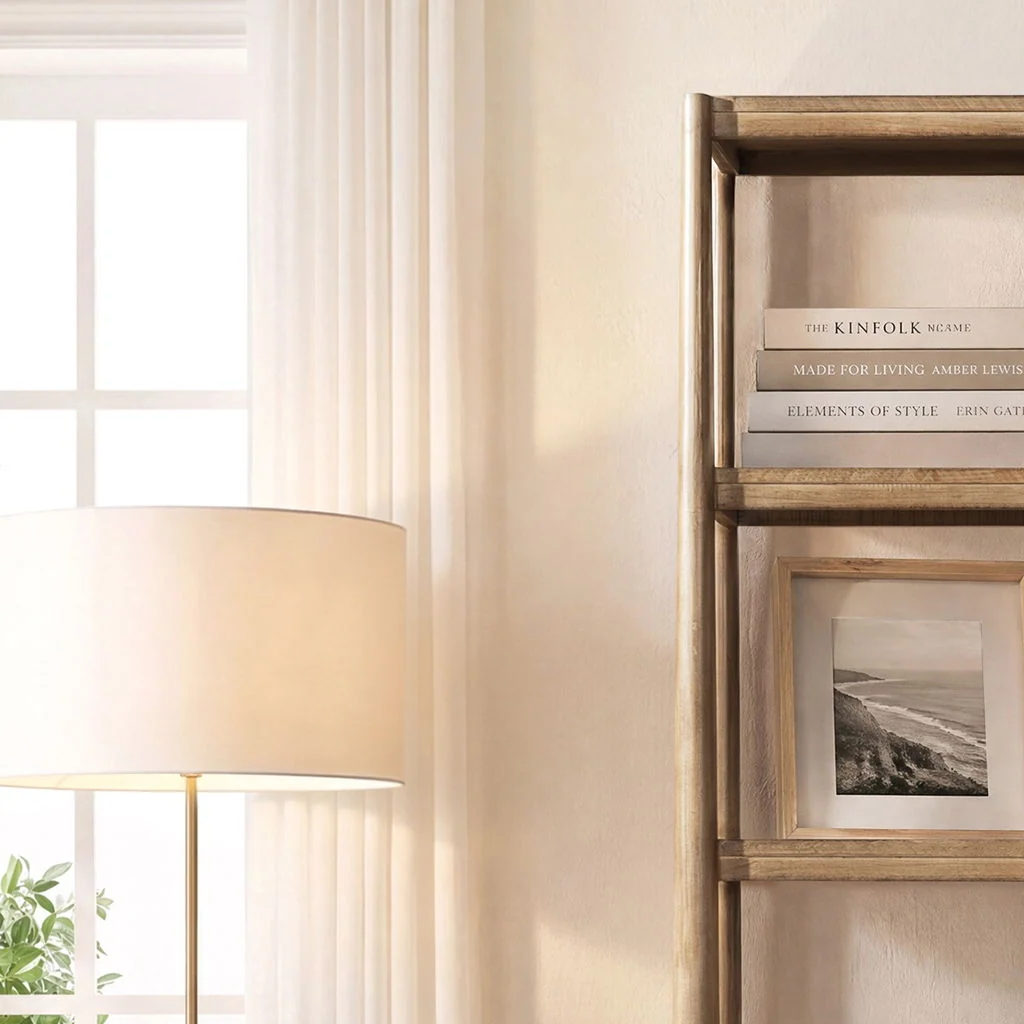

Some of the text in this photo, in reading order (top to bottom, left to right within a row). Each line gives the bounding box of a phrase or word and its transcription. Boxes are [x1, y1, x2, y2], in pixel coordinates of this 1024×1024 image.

[804, 323, 829, 333] THE
[834, 321, 922, 335] KINFOLK
[793, 364, 1024, 376] MADE FOR LIVING AMBER LEWIS
[787, 405, 865, 417] ELEMENTS
[870, 405, 890, 417] OF
[894, 405, 939, 417] STYLE
[956, 406, 989, 416] ERIN
